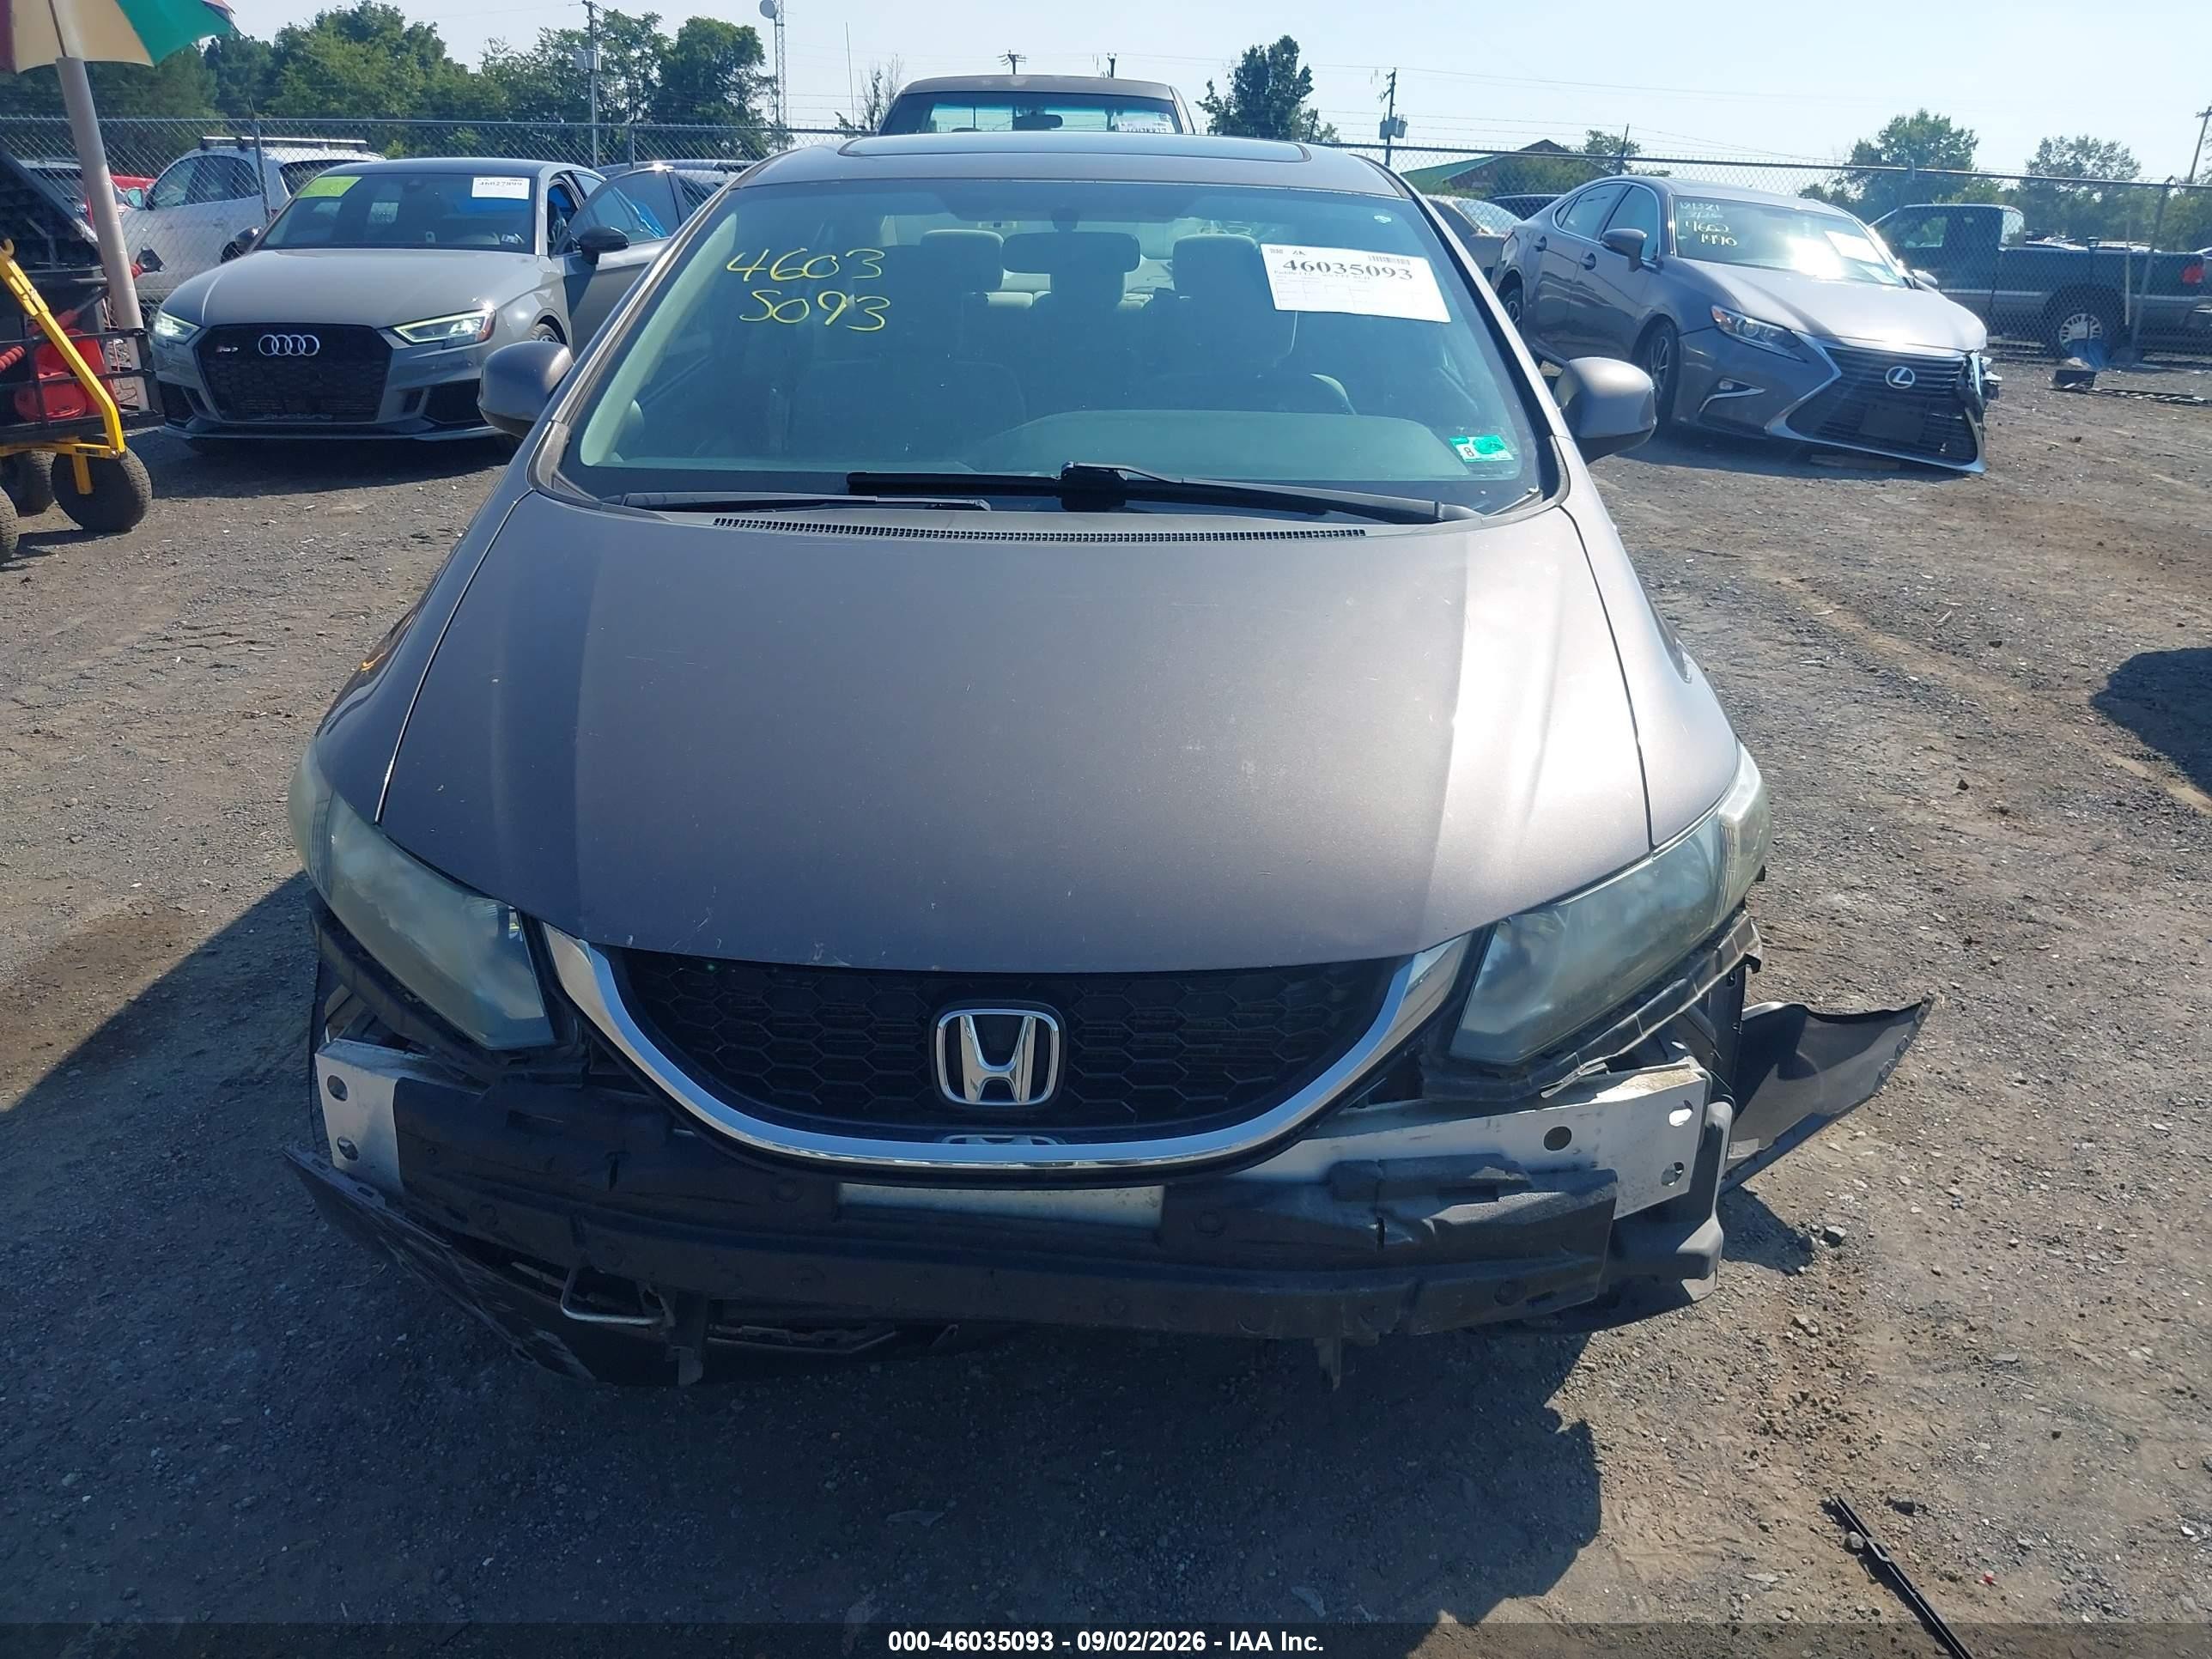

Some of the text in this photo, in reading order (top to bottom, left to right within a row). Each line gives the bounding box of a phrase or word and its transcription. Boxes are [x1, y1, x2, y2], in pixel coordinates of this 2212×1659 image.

[726, 247, 885, 282] 4603
[1282, 259, 1413, 281] 46035093
[738, 289, 890, 331] 5093
